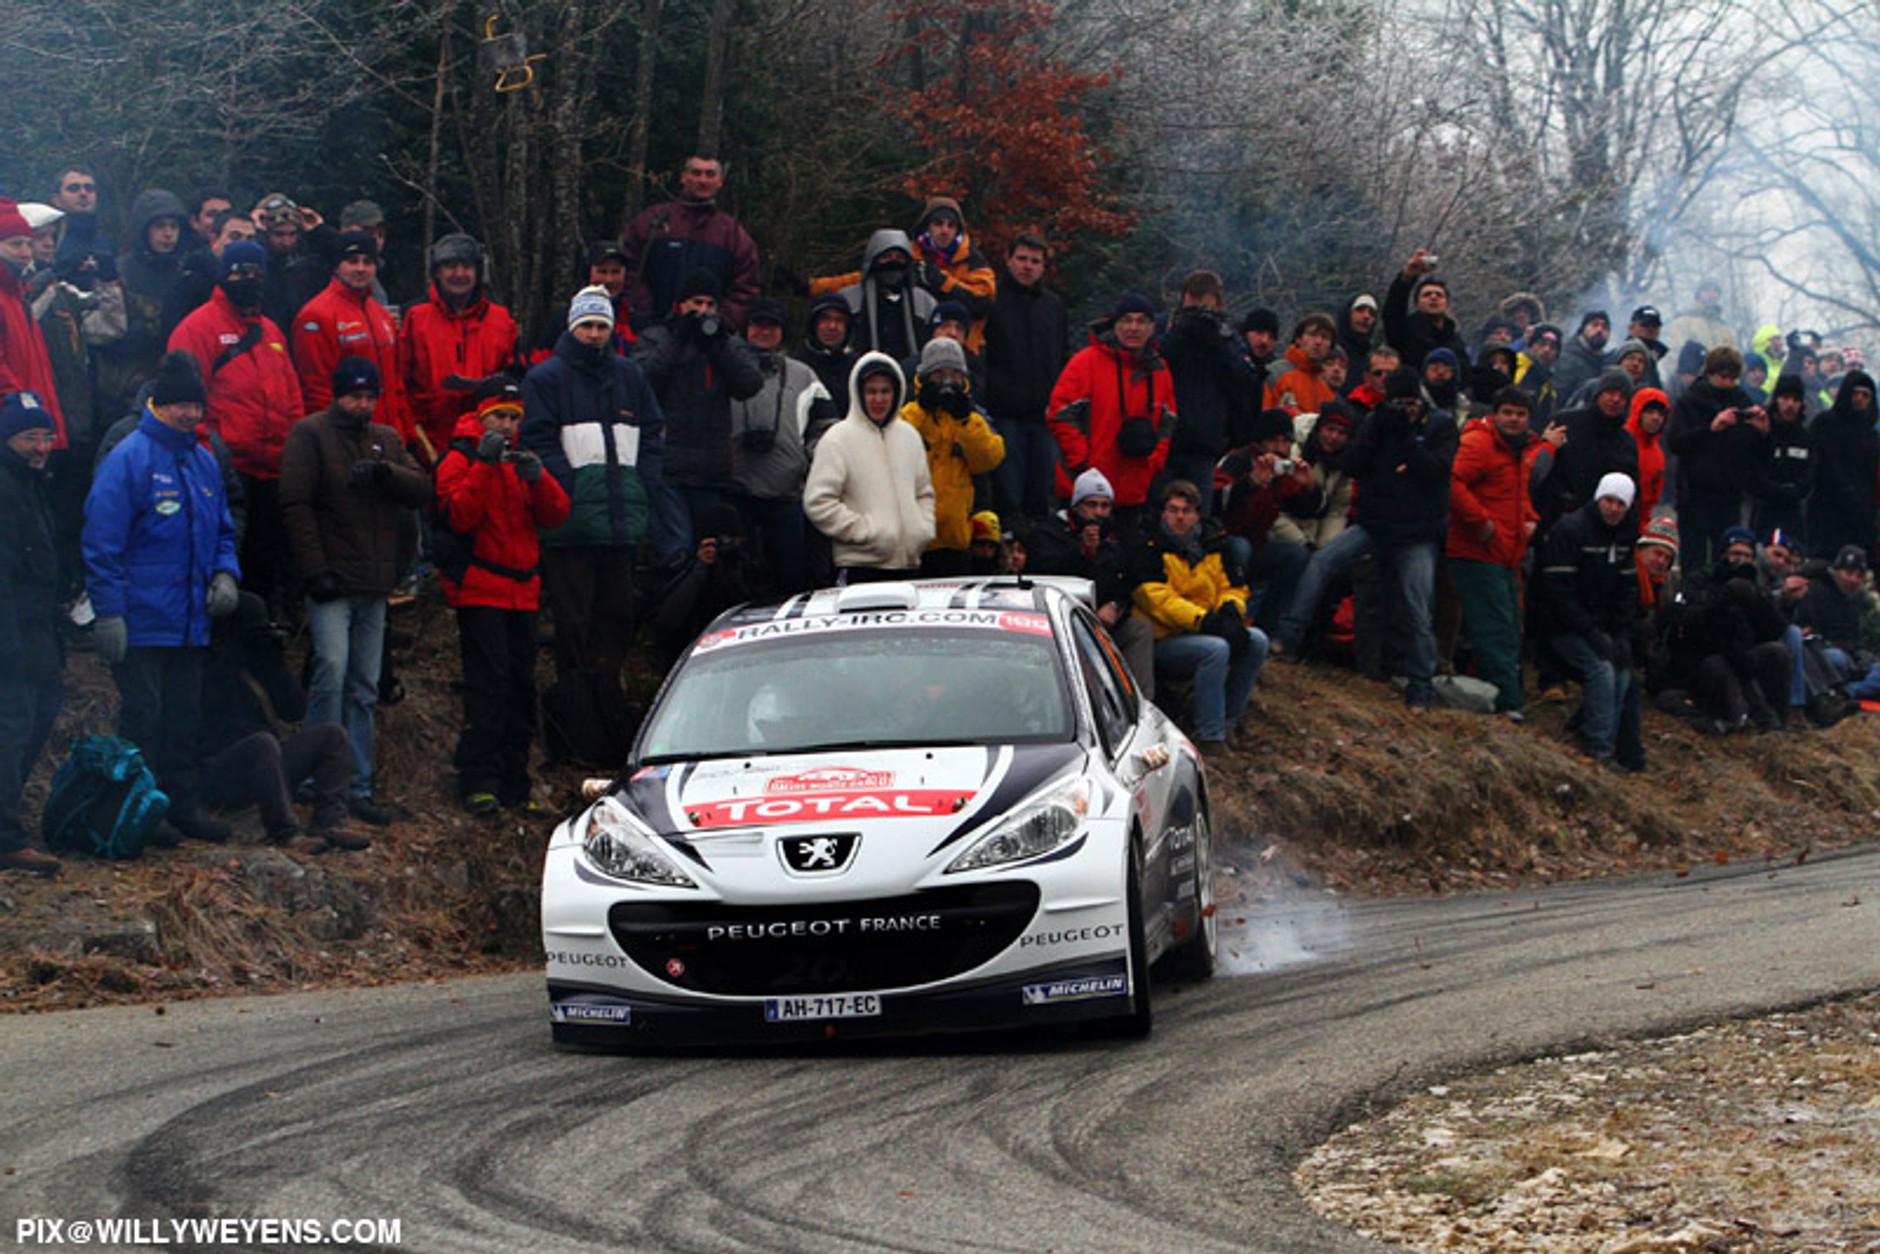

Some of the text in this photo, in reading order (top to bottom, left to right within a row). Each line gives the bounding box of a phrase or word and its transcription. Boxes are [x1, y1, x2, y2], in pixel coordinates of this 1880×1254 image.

[737, 612, 998, 640] RALLY-IRC.COM
[716, 795, 933, 821] TOTAL
[708, 915, 941, 940] PEUGEOT FRANCE
[1020, 923, 1124, 947] PEUGEOT
[546, 951, 627, 968] PEUGEOT
[1049, 978, 1123, 995] MICHELIN
[566, 1005, 626, 1019] MICHELIN
[782, 996, 877, 1018] AH-717-EC
